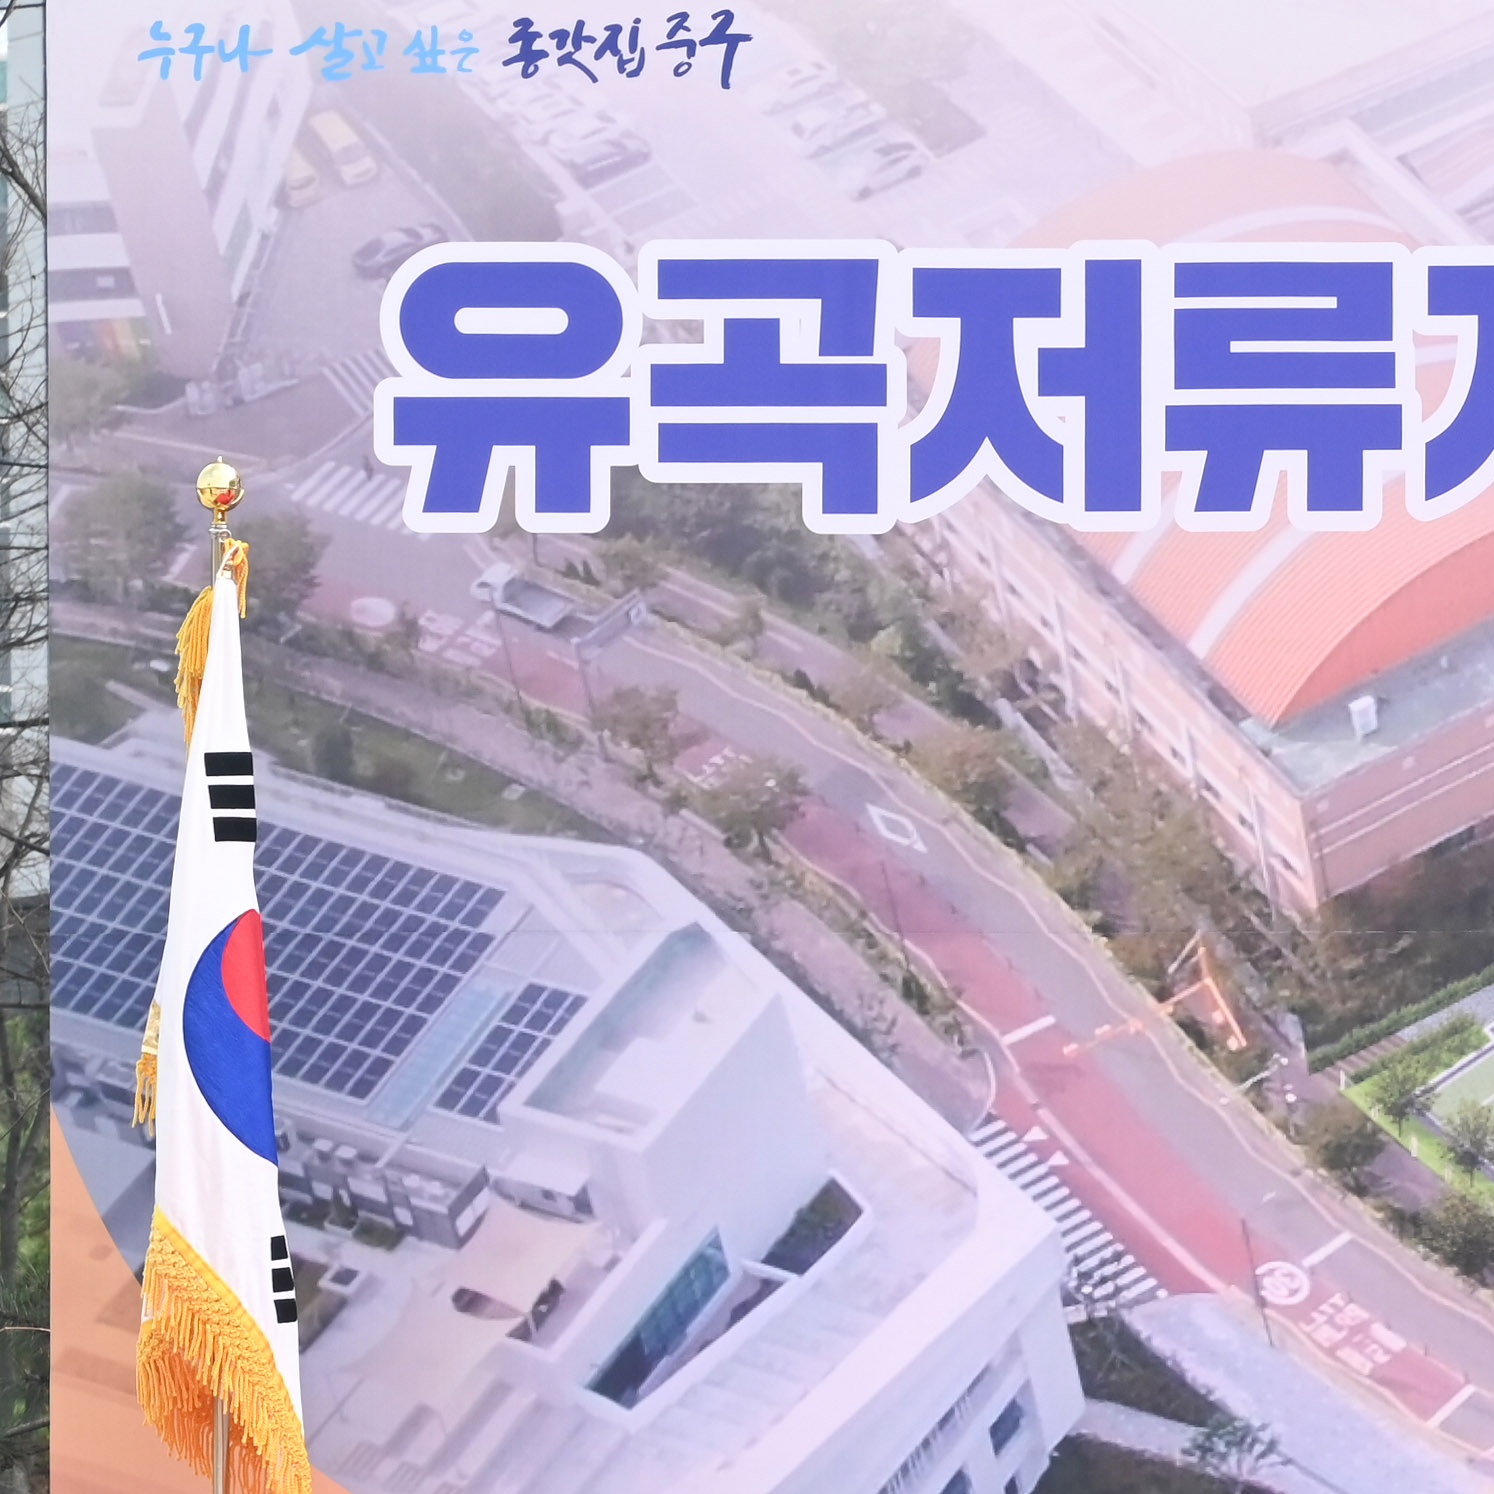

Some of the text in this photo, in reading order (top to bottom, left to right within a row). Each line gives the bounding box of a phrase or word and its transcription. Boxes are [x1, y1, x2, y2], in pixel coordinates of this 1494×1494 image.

[137, 9, 754, 89] 누구나 살고 싶은 종갓집 중구
